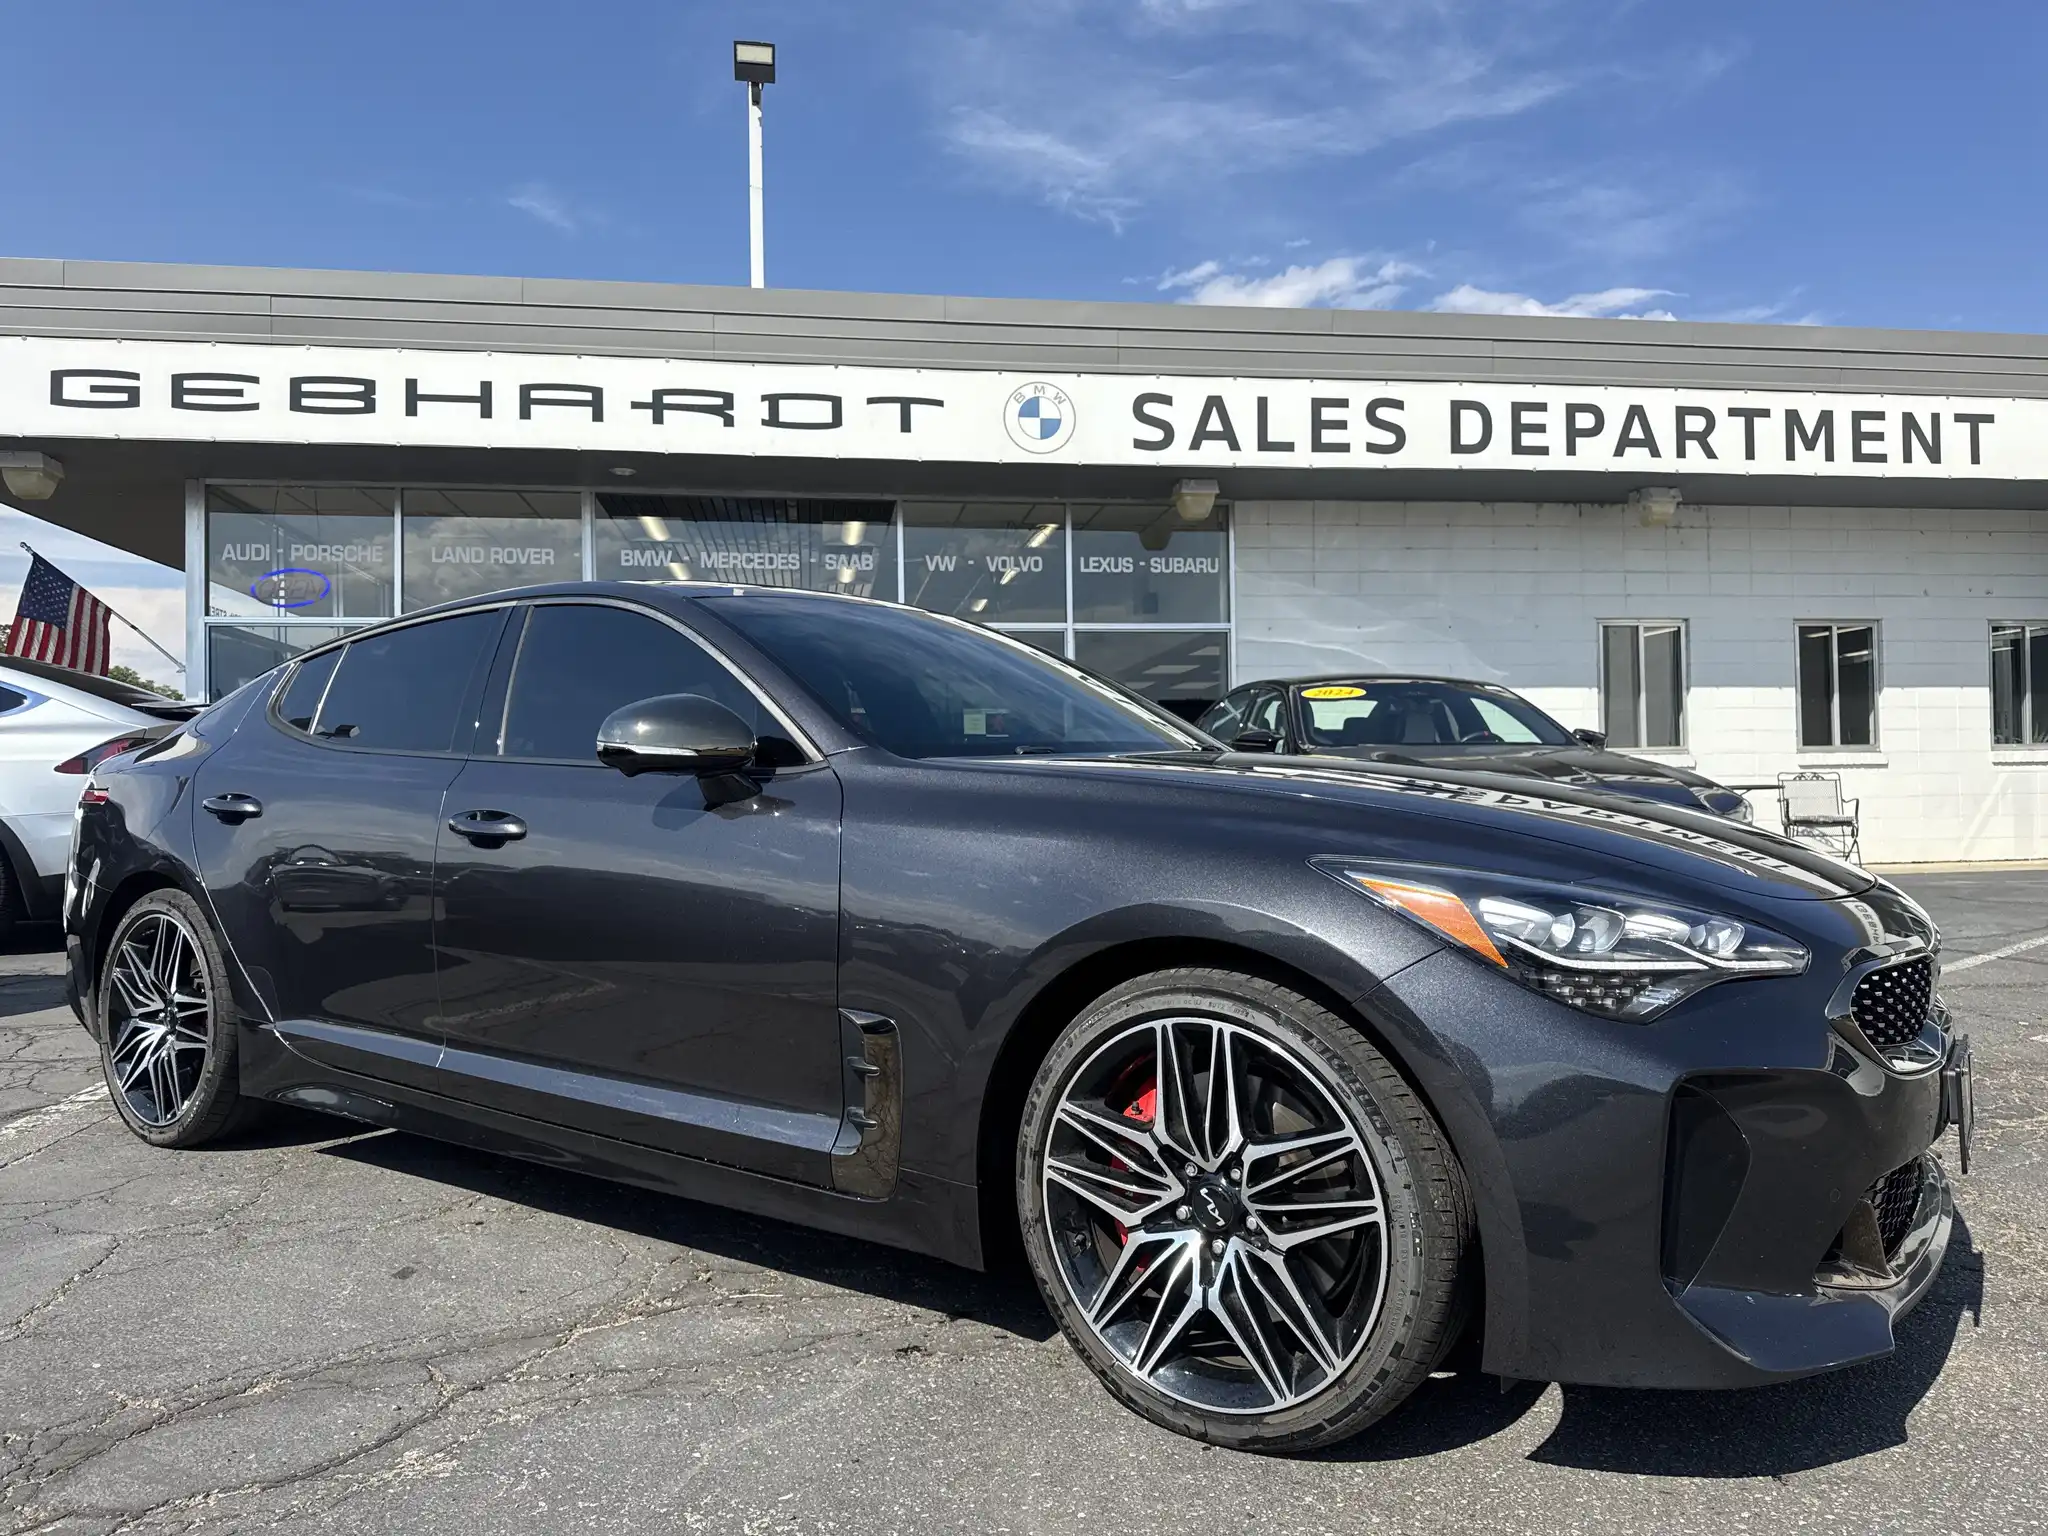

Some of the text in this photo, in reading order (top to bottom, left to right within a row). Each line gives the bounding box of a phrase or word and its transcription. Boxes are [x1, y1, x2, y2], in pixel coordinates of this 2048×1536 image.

[50, 368, 945, 433] GEBHARDT
[1013, 385, 1066, 404] BMW
[1132, 393, 1995, 465] SALES DEPARTMENT
[222, 543, 270, 561] AUDI
[290, 545, 383, 562] PORSCHE
[431, 546, 484, 563] LAND
[490, 548, 555, 565] ROVER
[620, 550, 672, 566] BMW
[701, 552, 800, 570] MERCEDES
[825, 554, 874, 570] SAAB
[925, 555, 956, 572] VW
[986, 556, 1043, 572] VOLVO
[1080, 557, 1134, 573] LEXUS
[1150, 557, 1219, 573] SUBARU
